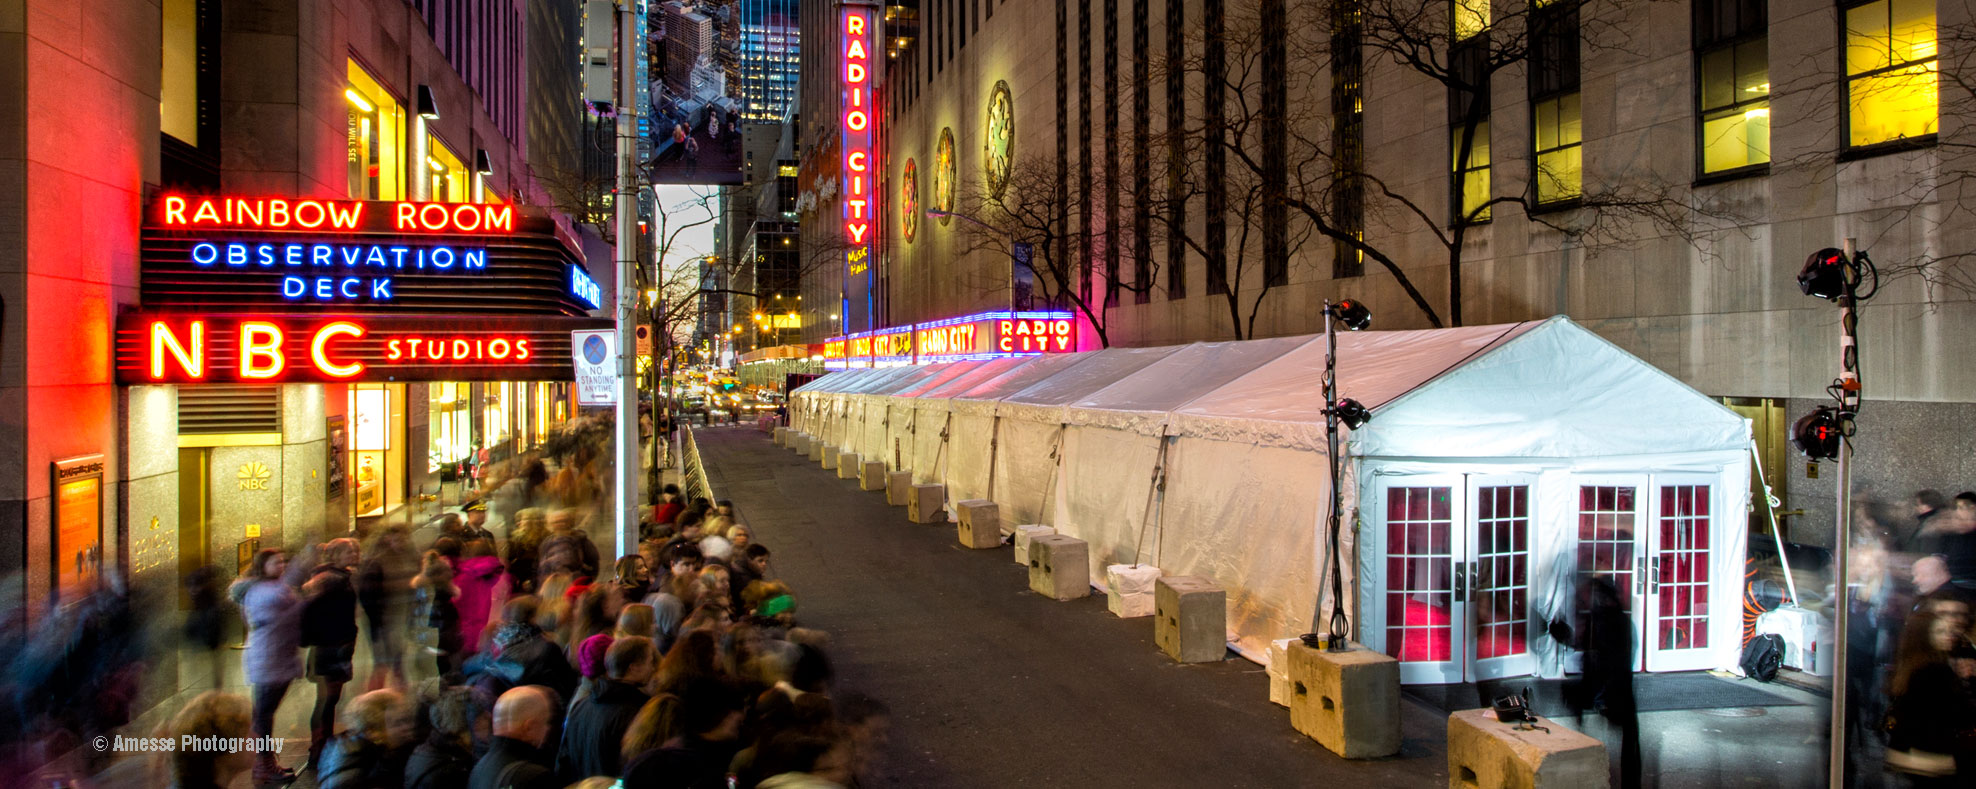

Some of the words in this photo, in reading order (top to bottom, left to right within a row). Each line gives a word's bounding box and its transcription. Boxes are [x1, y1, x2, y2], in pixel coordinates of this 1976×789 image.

[847, 15, 867, 130] RADIO
[347, 128, 356, 146] WILL
[347, 148, 357, 162] SEE
[848, 151, 867, 243] CITY
[166, 196, 362, 229] RAINBOW
[397, 202, 513, 232] ROOM
[193, 243, 485, 269] OBSERVATION
[284, 277, 391, 298] DECK
[1000, 320, 1070, 335] RADIO
[921, 328, 948, 354] RADIO
[949, 324, 976, 351] CITY
[1000, 336, 1070, 352] CITY
[150, 320, 366, 380] NBC
[387, 338, 529, 360] STUDIOS
[589, 367, 603, 375] NO
[580, 376, 615, 385] STANDING
[584, 384, 613, 393] ANYTIME
[239, 479, 268, 491] NBC
